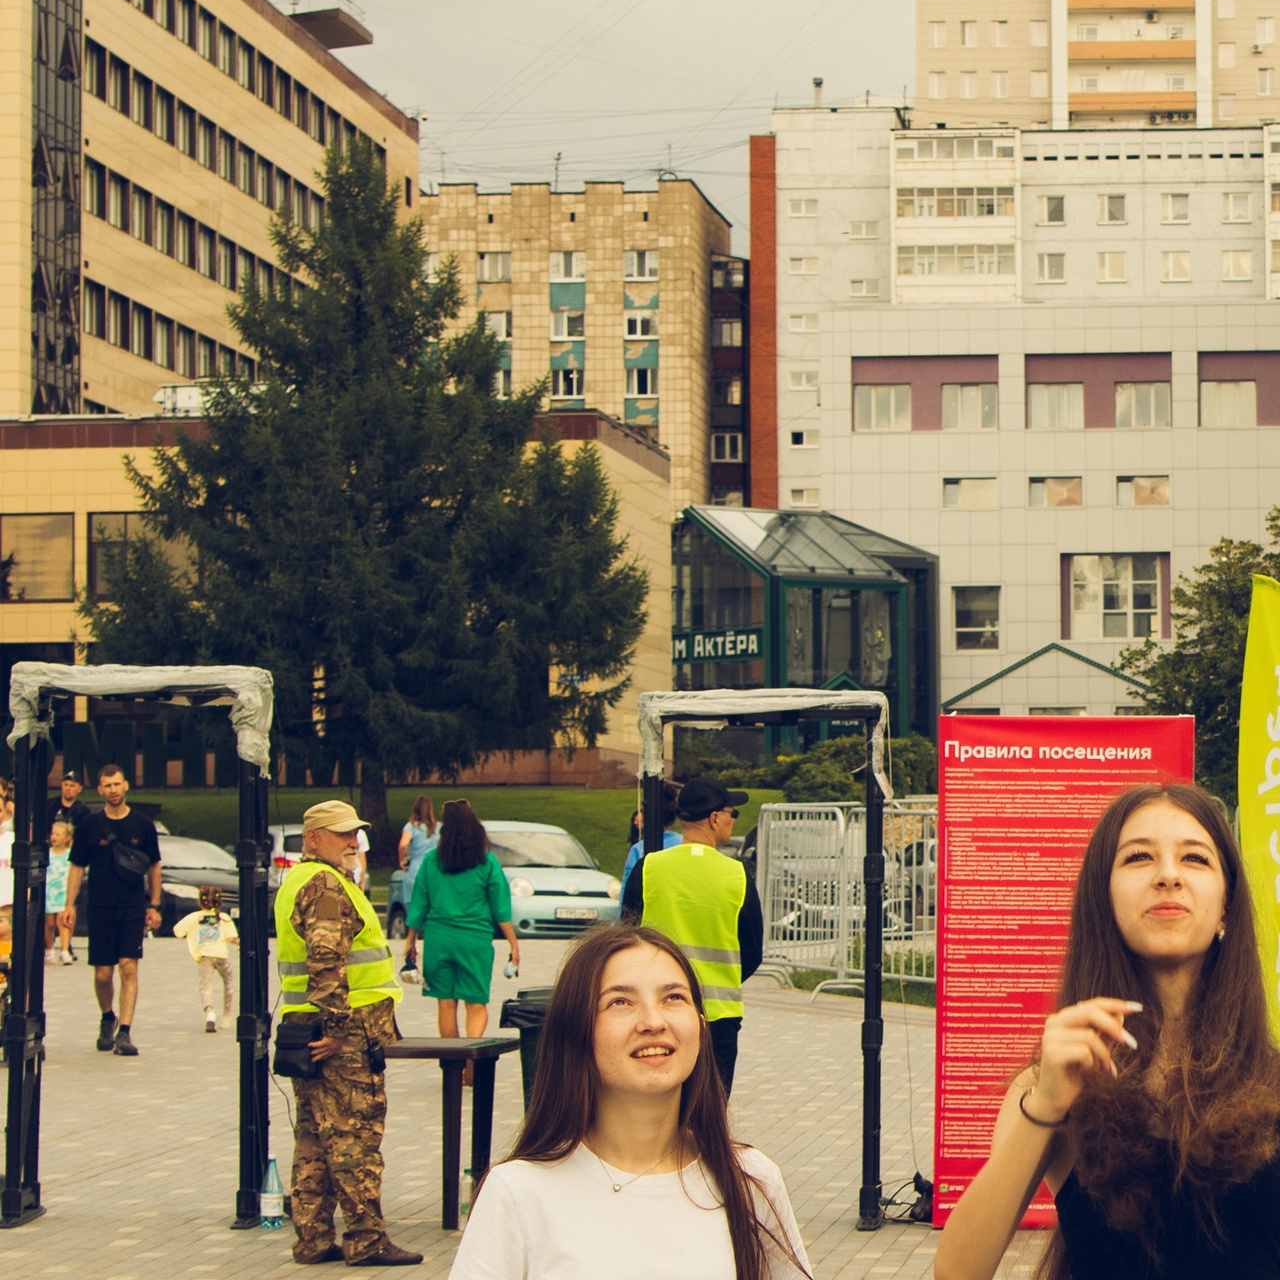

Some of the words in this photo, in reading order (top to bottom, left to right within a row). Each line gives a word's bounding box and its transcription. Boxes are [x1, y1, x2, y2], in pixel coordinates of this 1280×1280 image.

[694, 631, 758, 658] АКТЁРА
[944, 740, 1033, 762] Правила
[1038, 744, 1152, 762] посещения
